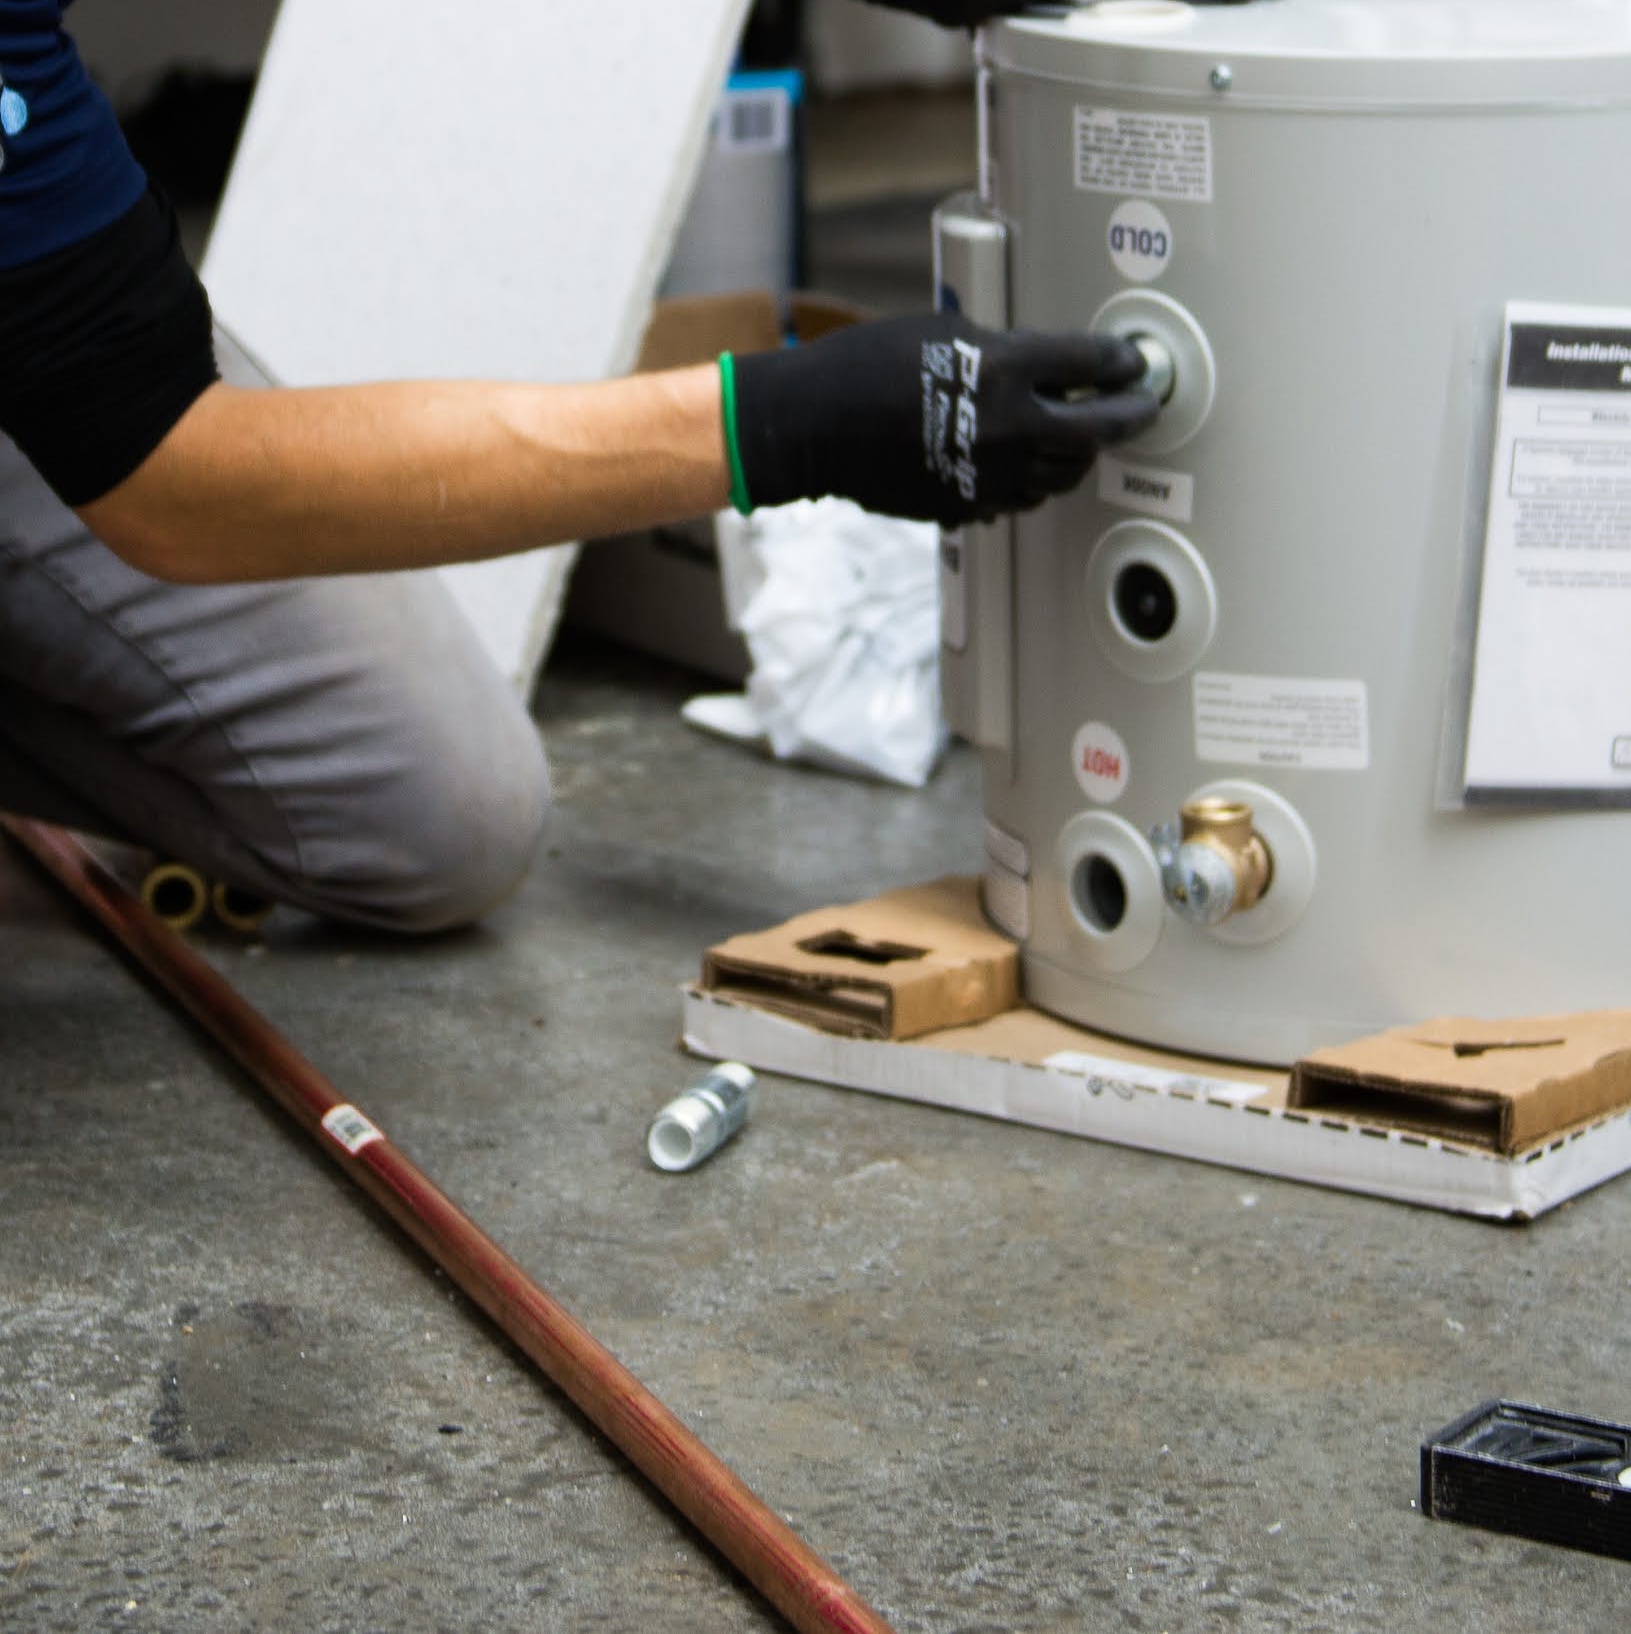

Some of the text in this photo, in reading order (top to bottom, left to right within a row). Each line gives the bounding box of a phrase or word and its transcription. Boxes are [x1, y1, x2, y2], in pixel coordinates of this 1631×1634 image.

[1110, 225, 1168, 258] COLD
[953, 338, 981, 501] P-Grip
[1083, 747, 1120, 780] HOT
